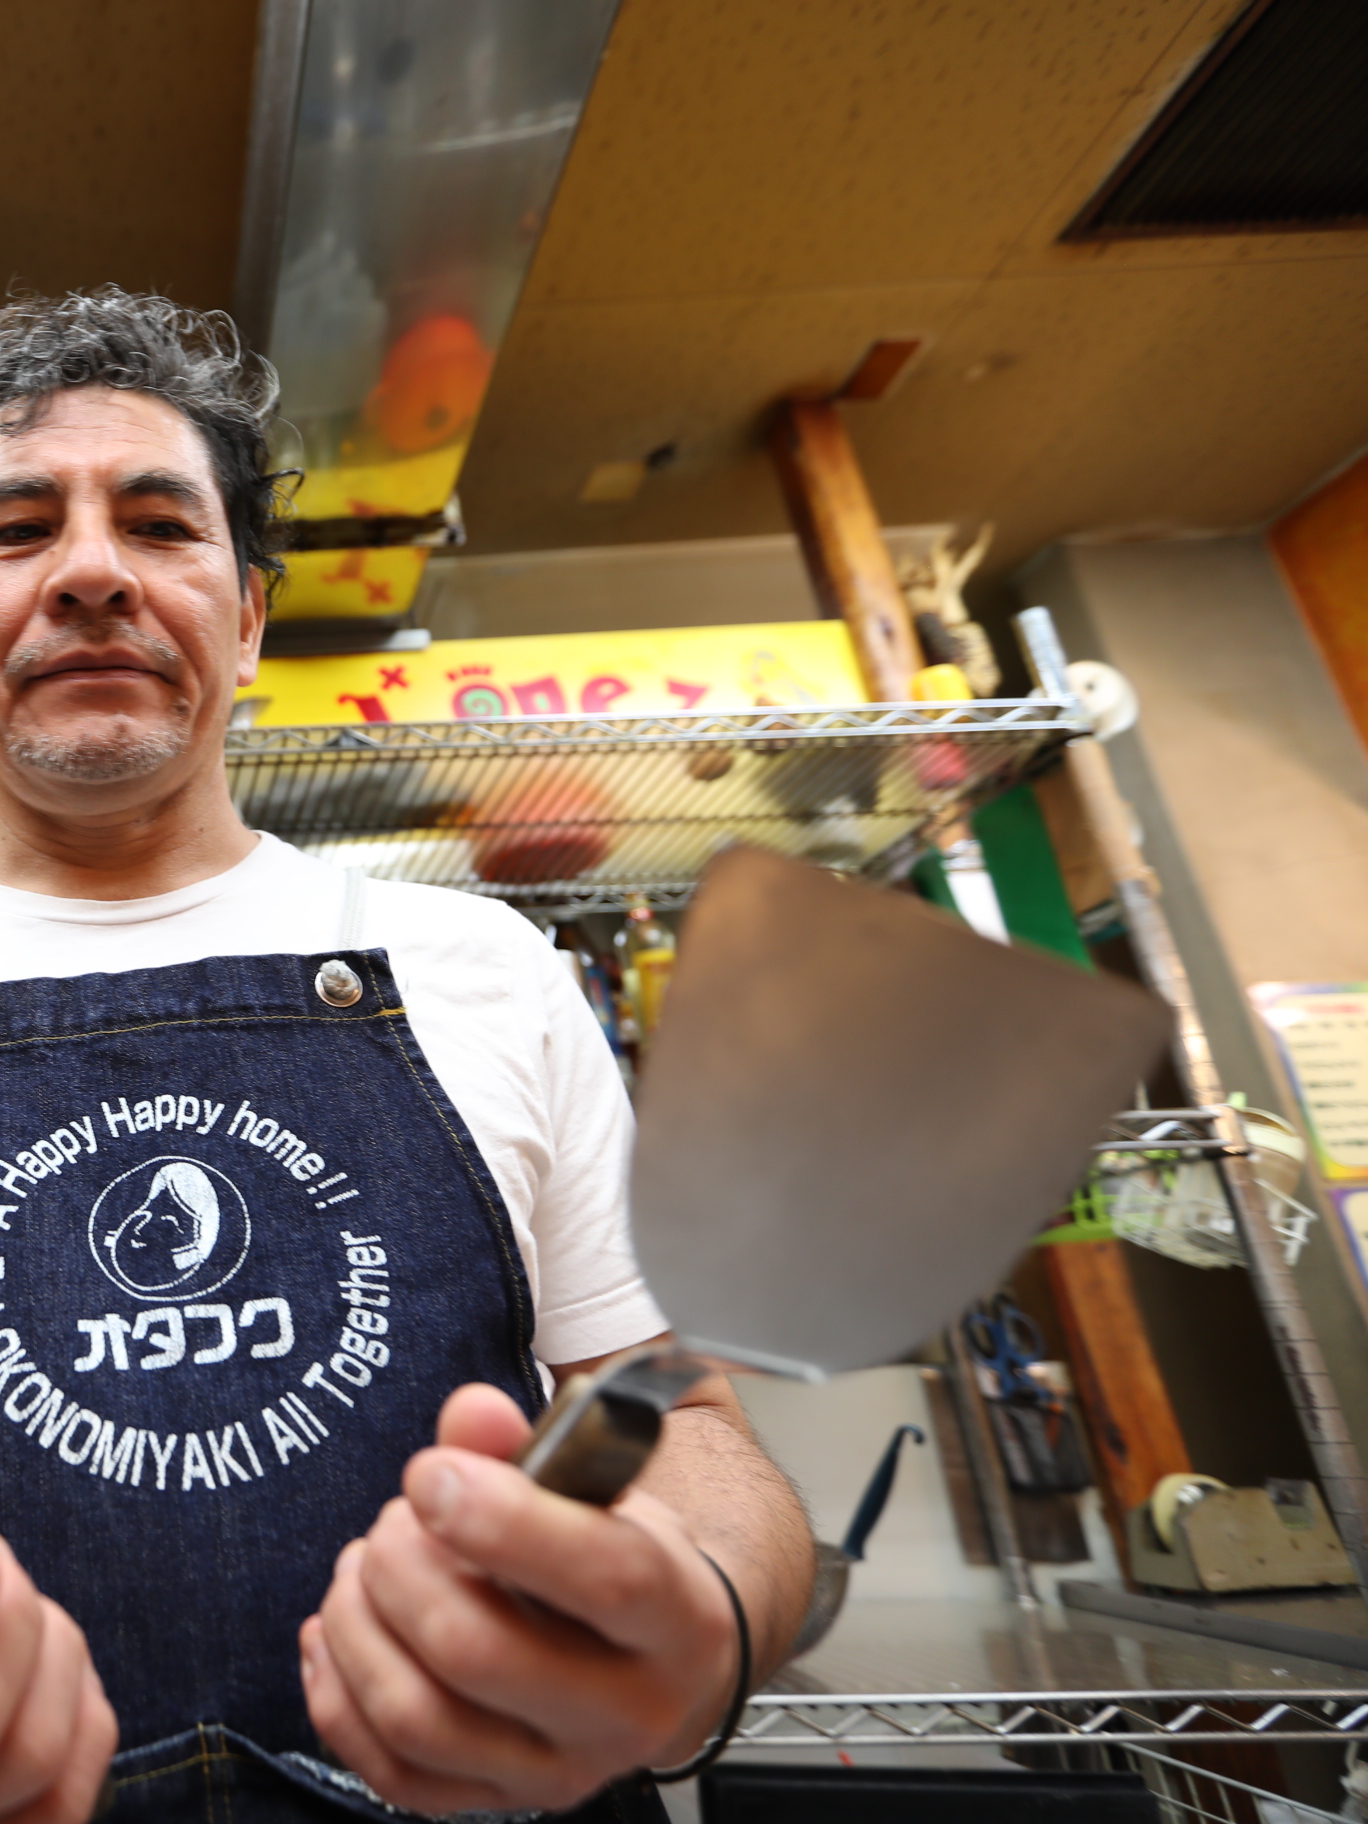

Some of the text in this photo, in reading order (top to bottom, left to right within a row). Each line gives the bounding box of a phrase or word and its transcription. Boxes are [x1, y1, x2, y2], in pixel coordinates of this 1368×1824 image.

[100, 1094, 226, 1138] Happy
[226, 1099, 361, 1210] home!!
[73, 1296, 296, 1372] オタフク
[261, 1391, 331, 1466] All
[301, 1230, 392, 1409] Together
